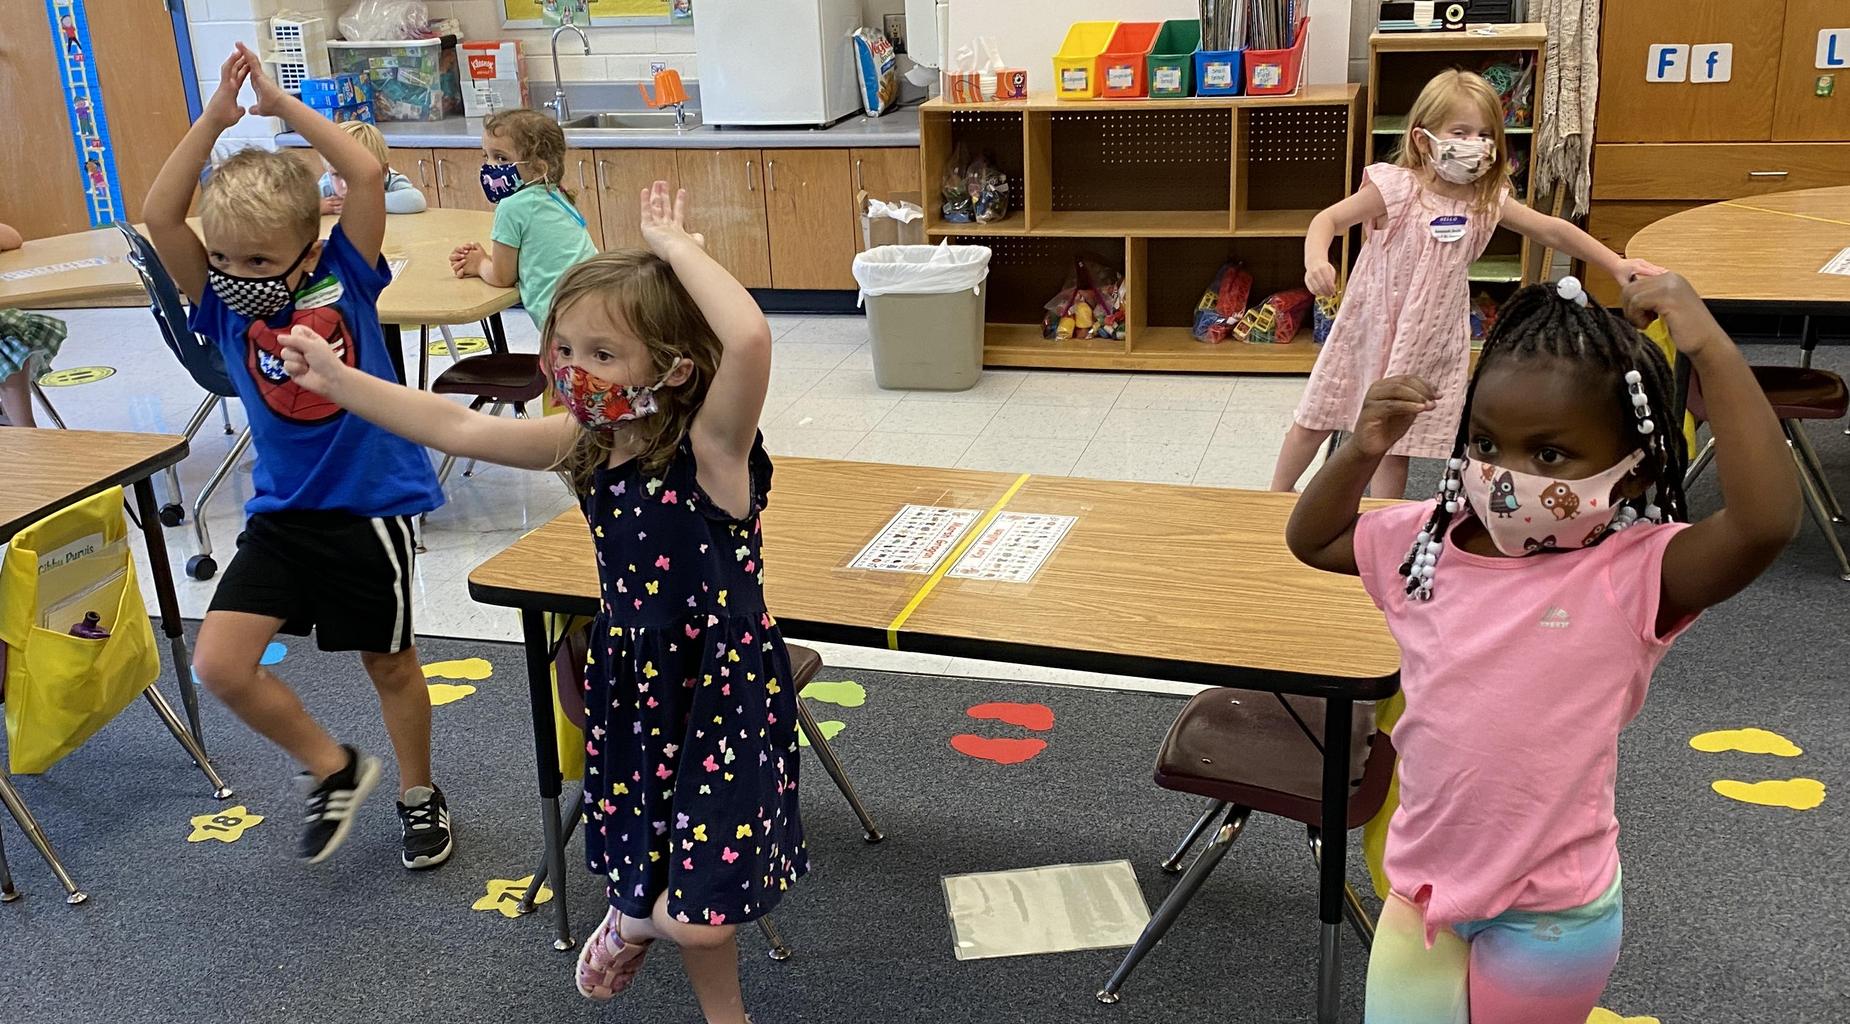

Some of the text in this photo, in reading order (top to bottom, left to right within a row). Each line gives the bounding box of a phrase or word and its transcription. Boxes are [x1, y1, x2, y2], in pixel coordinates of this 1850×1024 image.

[1656, 47, 1720, 79] F f
[1826, 33, 1844, 66] L
[202, 815, 243, 832] 18
